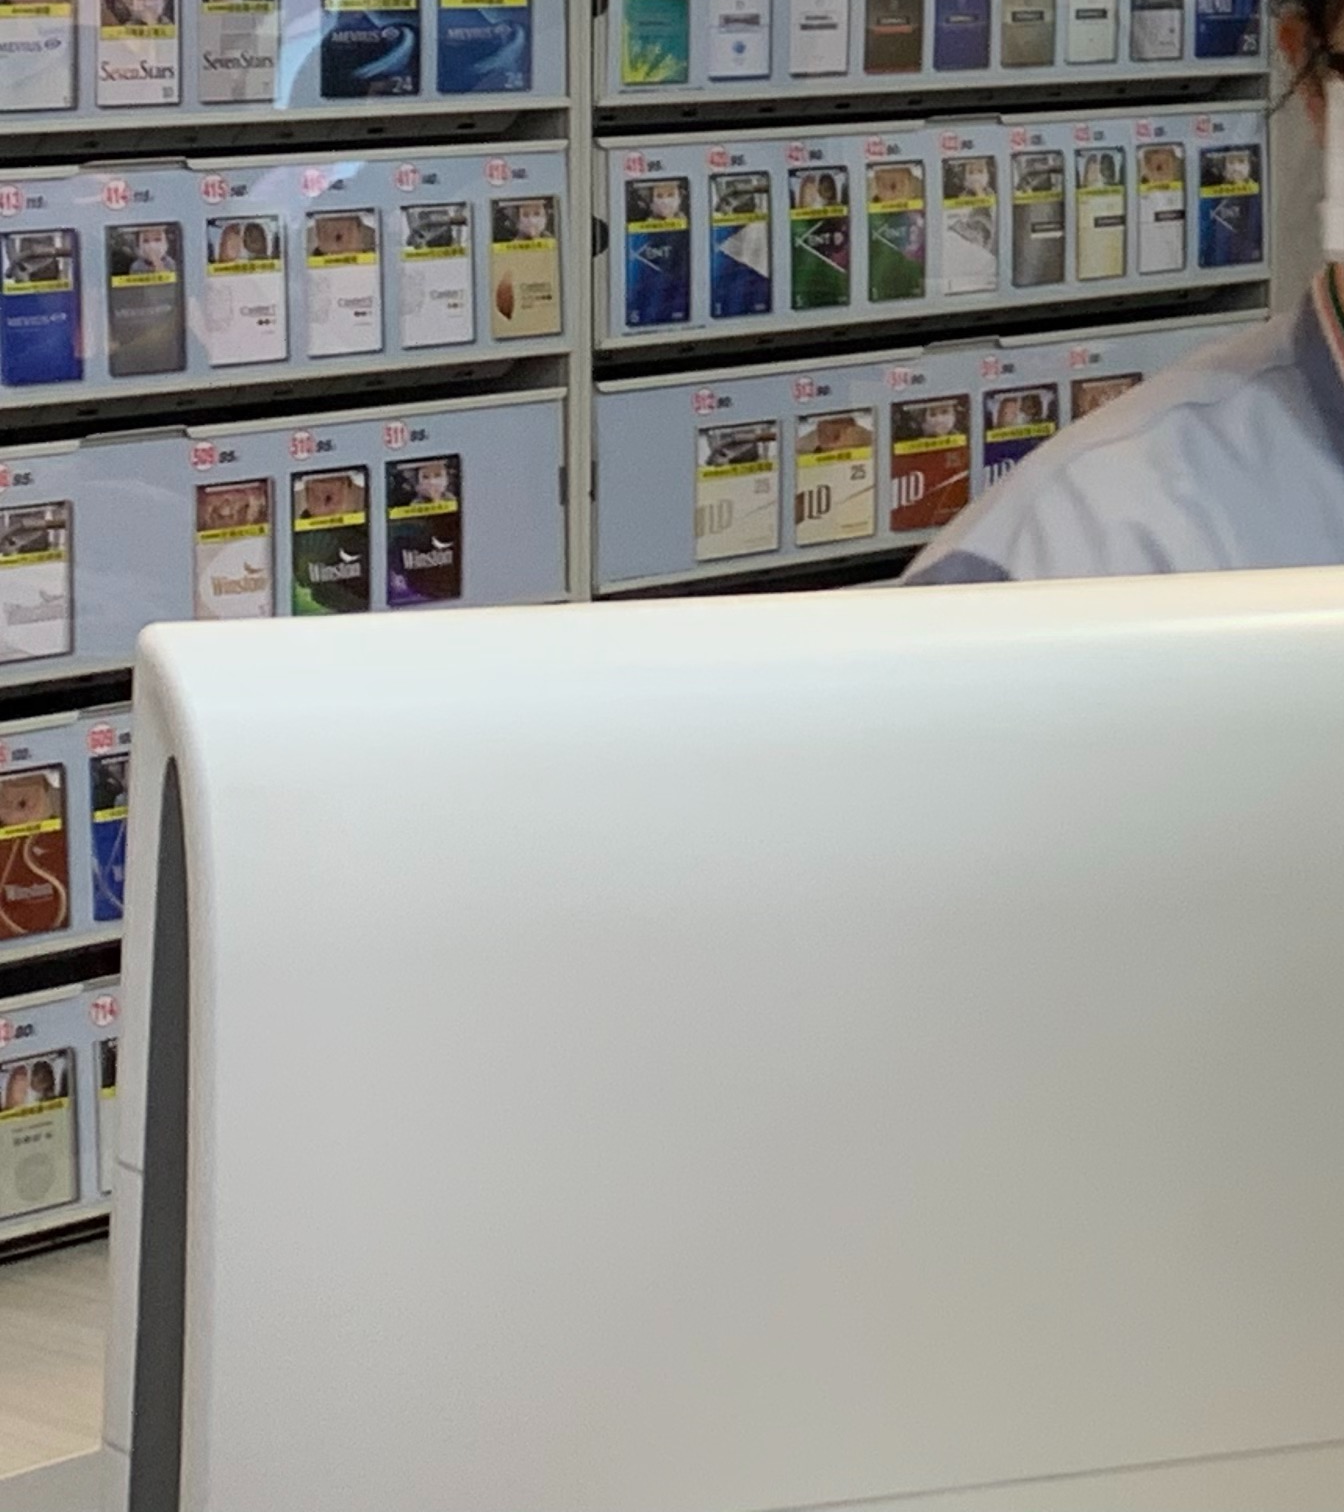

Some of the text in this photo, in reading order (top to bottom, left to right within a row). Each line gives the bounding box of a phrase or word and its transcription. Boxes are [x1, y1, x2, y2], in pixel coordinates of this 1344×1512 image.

[850, 464, 867, 482] 25
[308, 558, 362, 584] Winston
[402, 547, 454, 571] Winston
[211, 573, 267, 597] Winston
